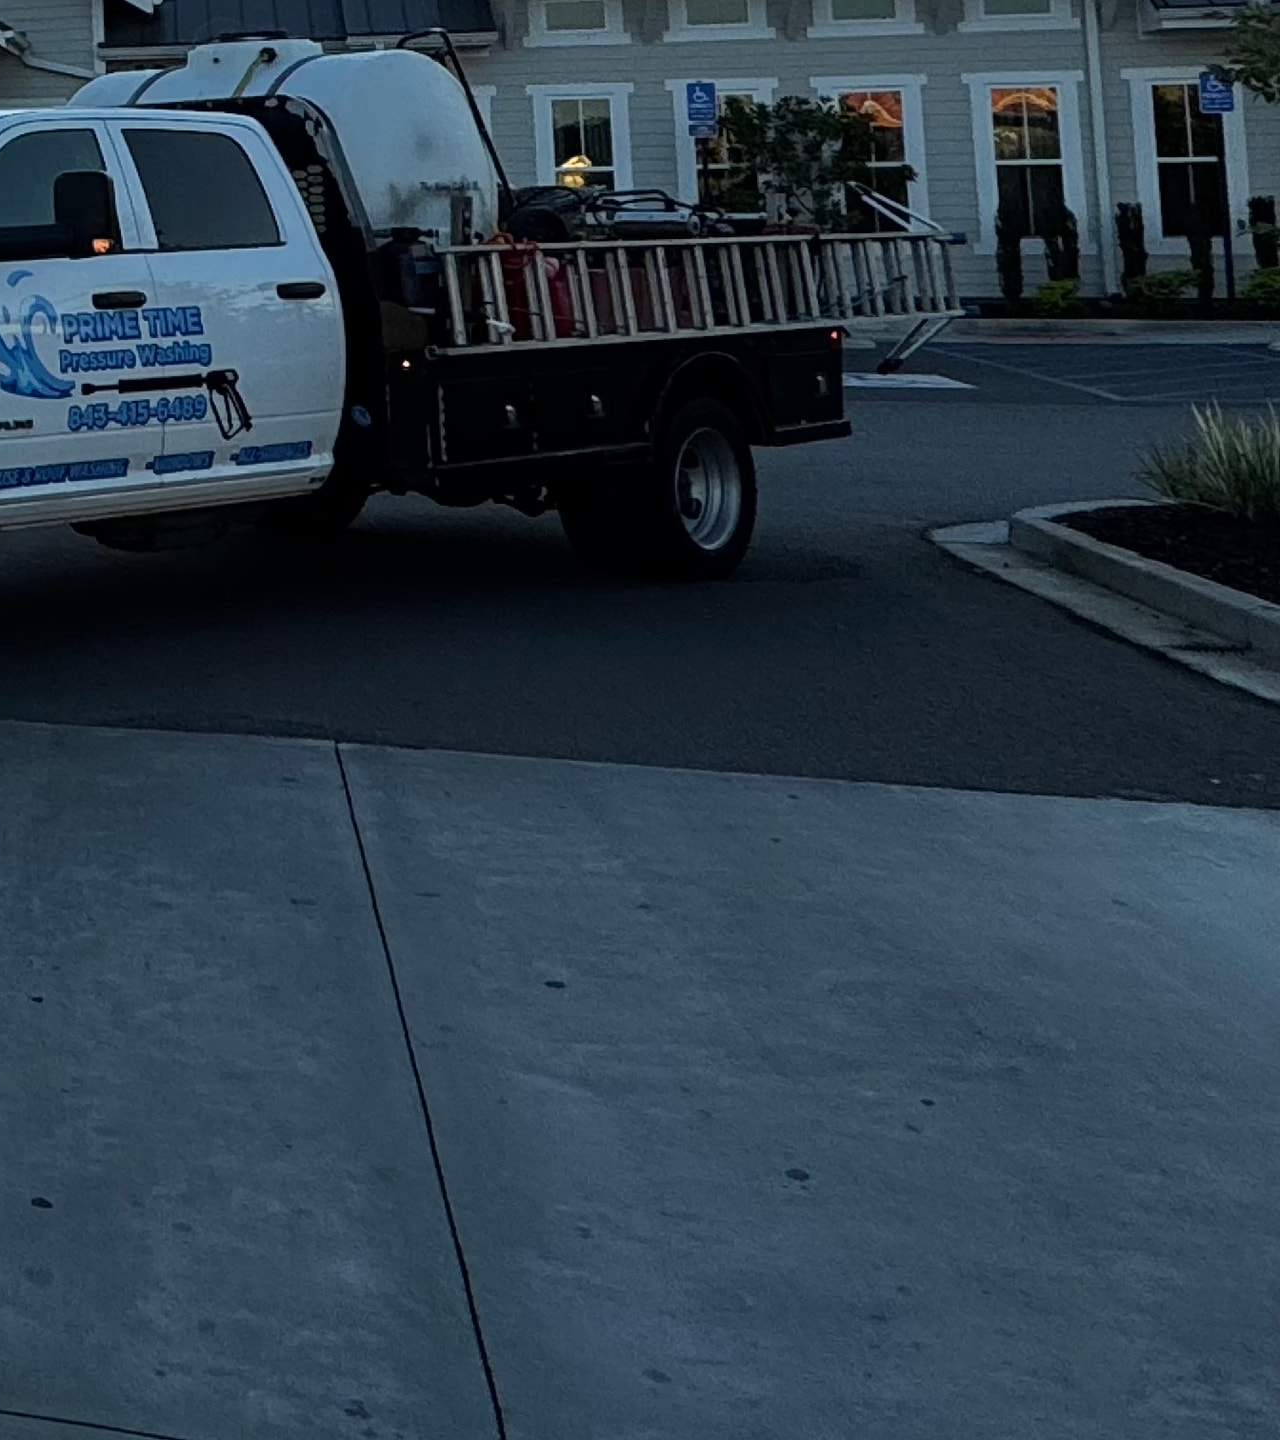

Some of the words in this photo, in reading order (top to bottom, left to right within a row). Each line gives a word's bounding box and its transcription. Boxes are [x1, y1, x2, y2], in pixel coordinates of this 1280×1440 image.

[61, 311, 141, 343] PRIME
[142, 306, 203, 337] TIME
[59, 349, 136, 373] Pressure
[136, 341, 212, 366] Washing
[68, 394, 208, 432] 843-415-6489
